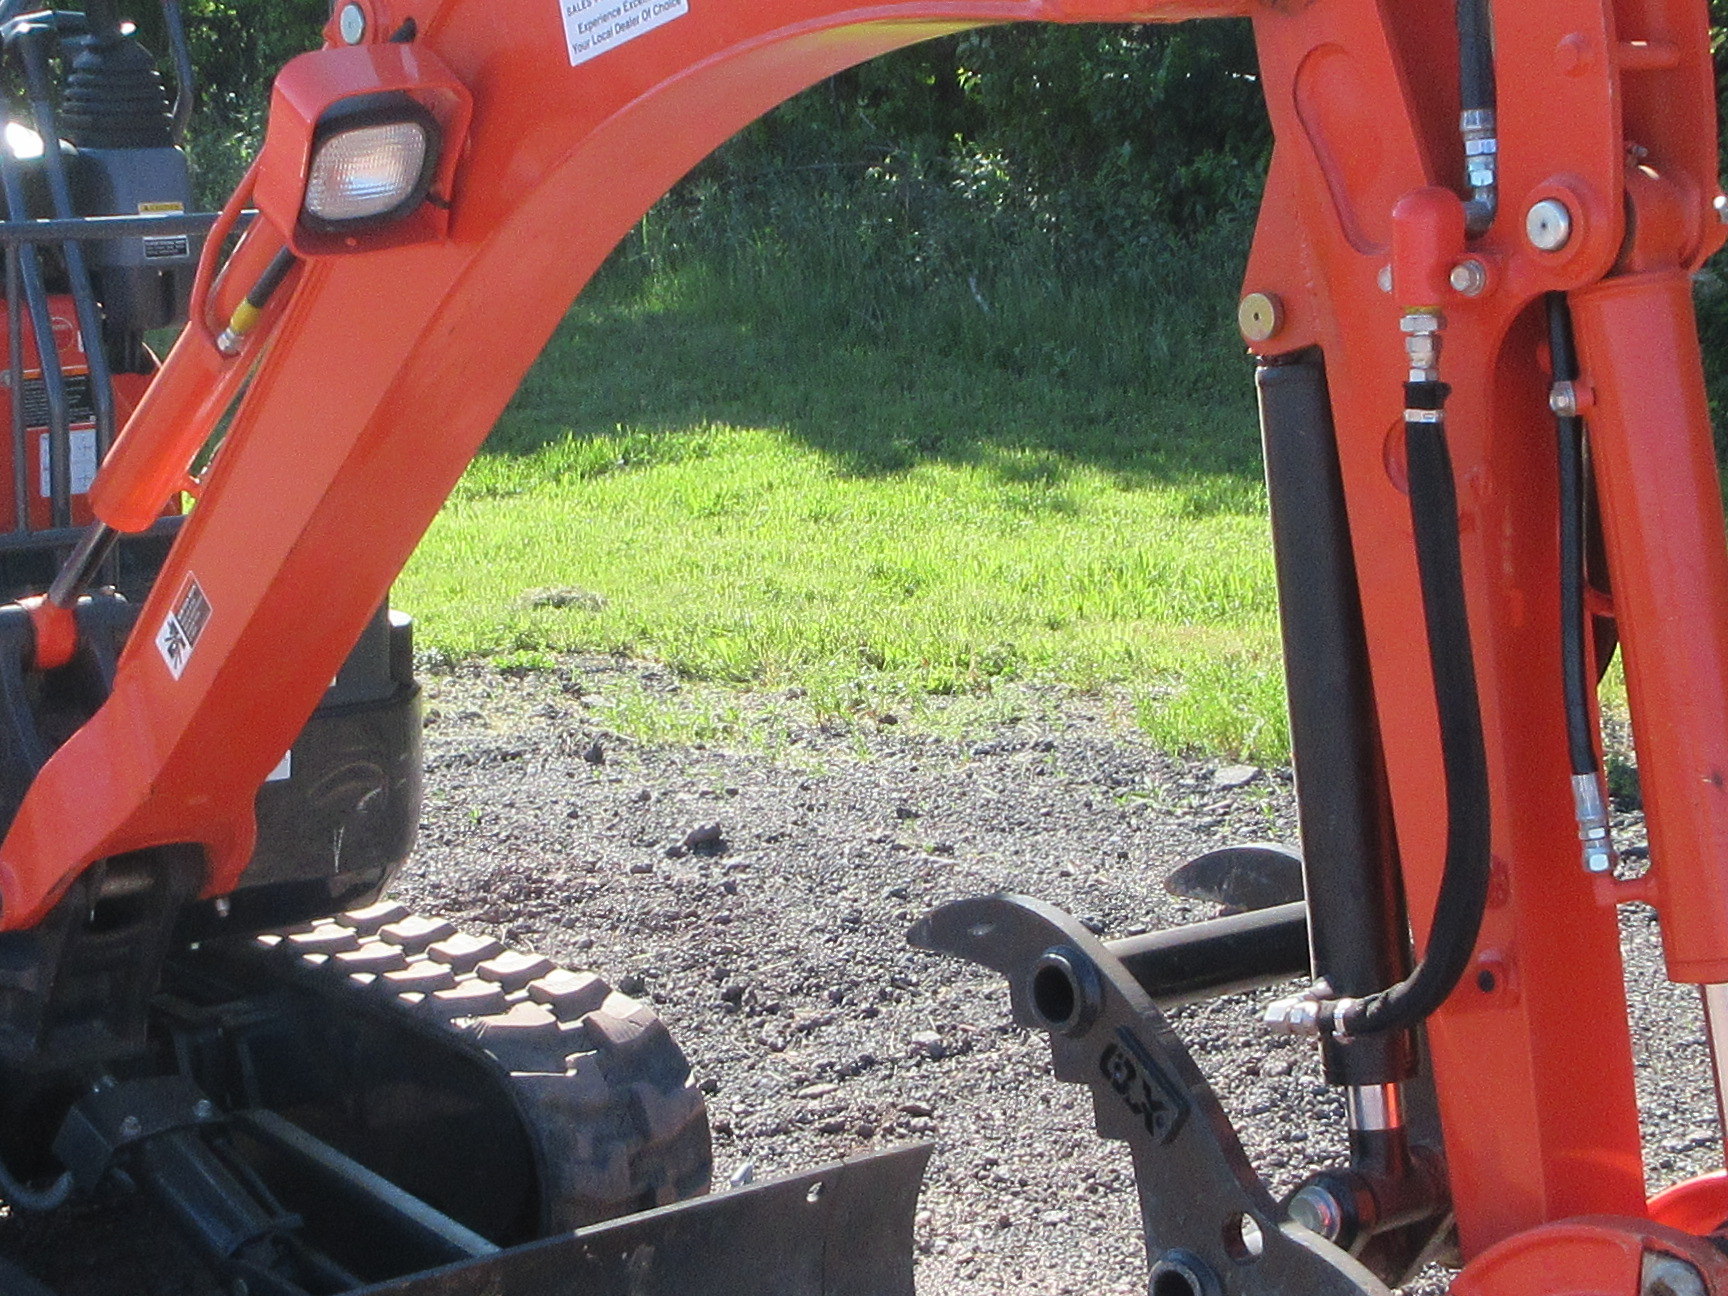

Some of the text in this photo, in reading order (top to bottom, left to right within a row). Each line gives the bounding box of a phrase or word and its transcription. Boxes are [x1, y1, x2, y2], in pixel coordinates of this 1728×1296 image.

[572, 38, 591, 55] Your
[591, 26, 613, 46] Local
[614, 14, 640, 35] Dealer
[641, 7, 652, 22] Of
[577, 6, 622, 35] Experience
